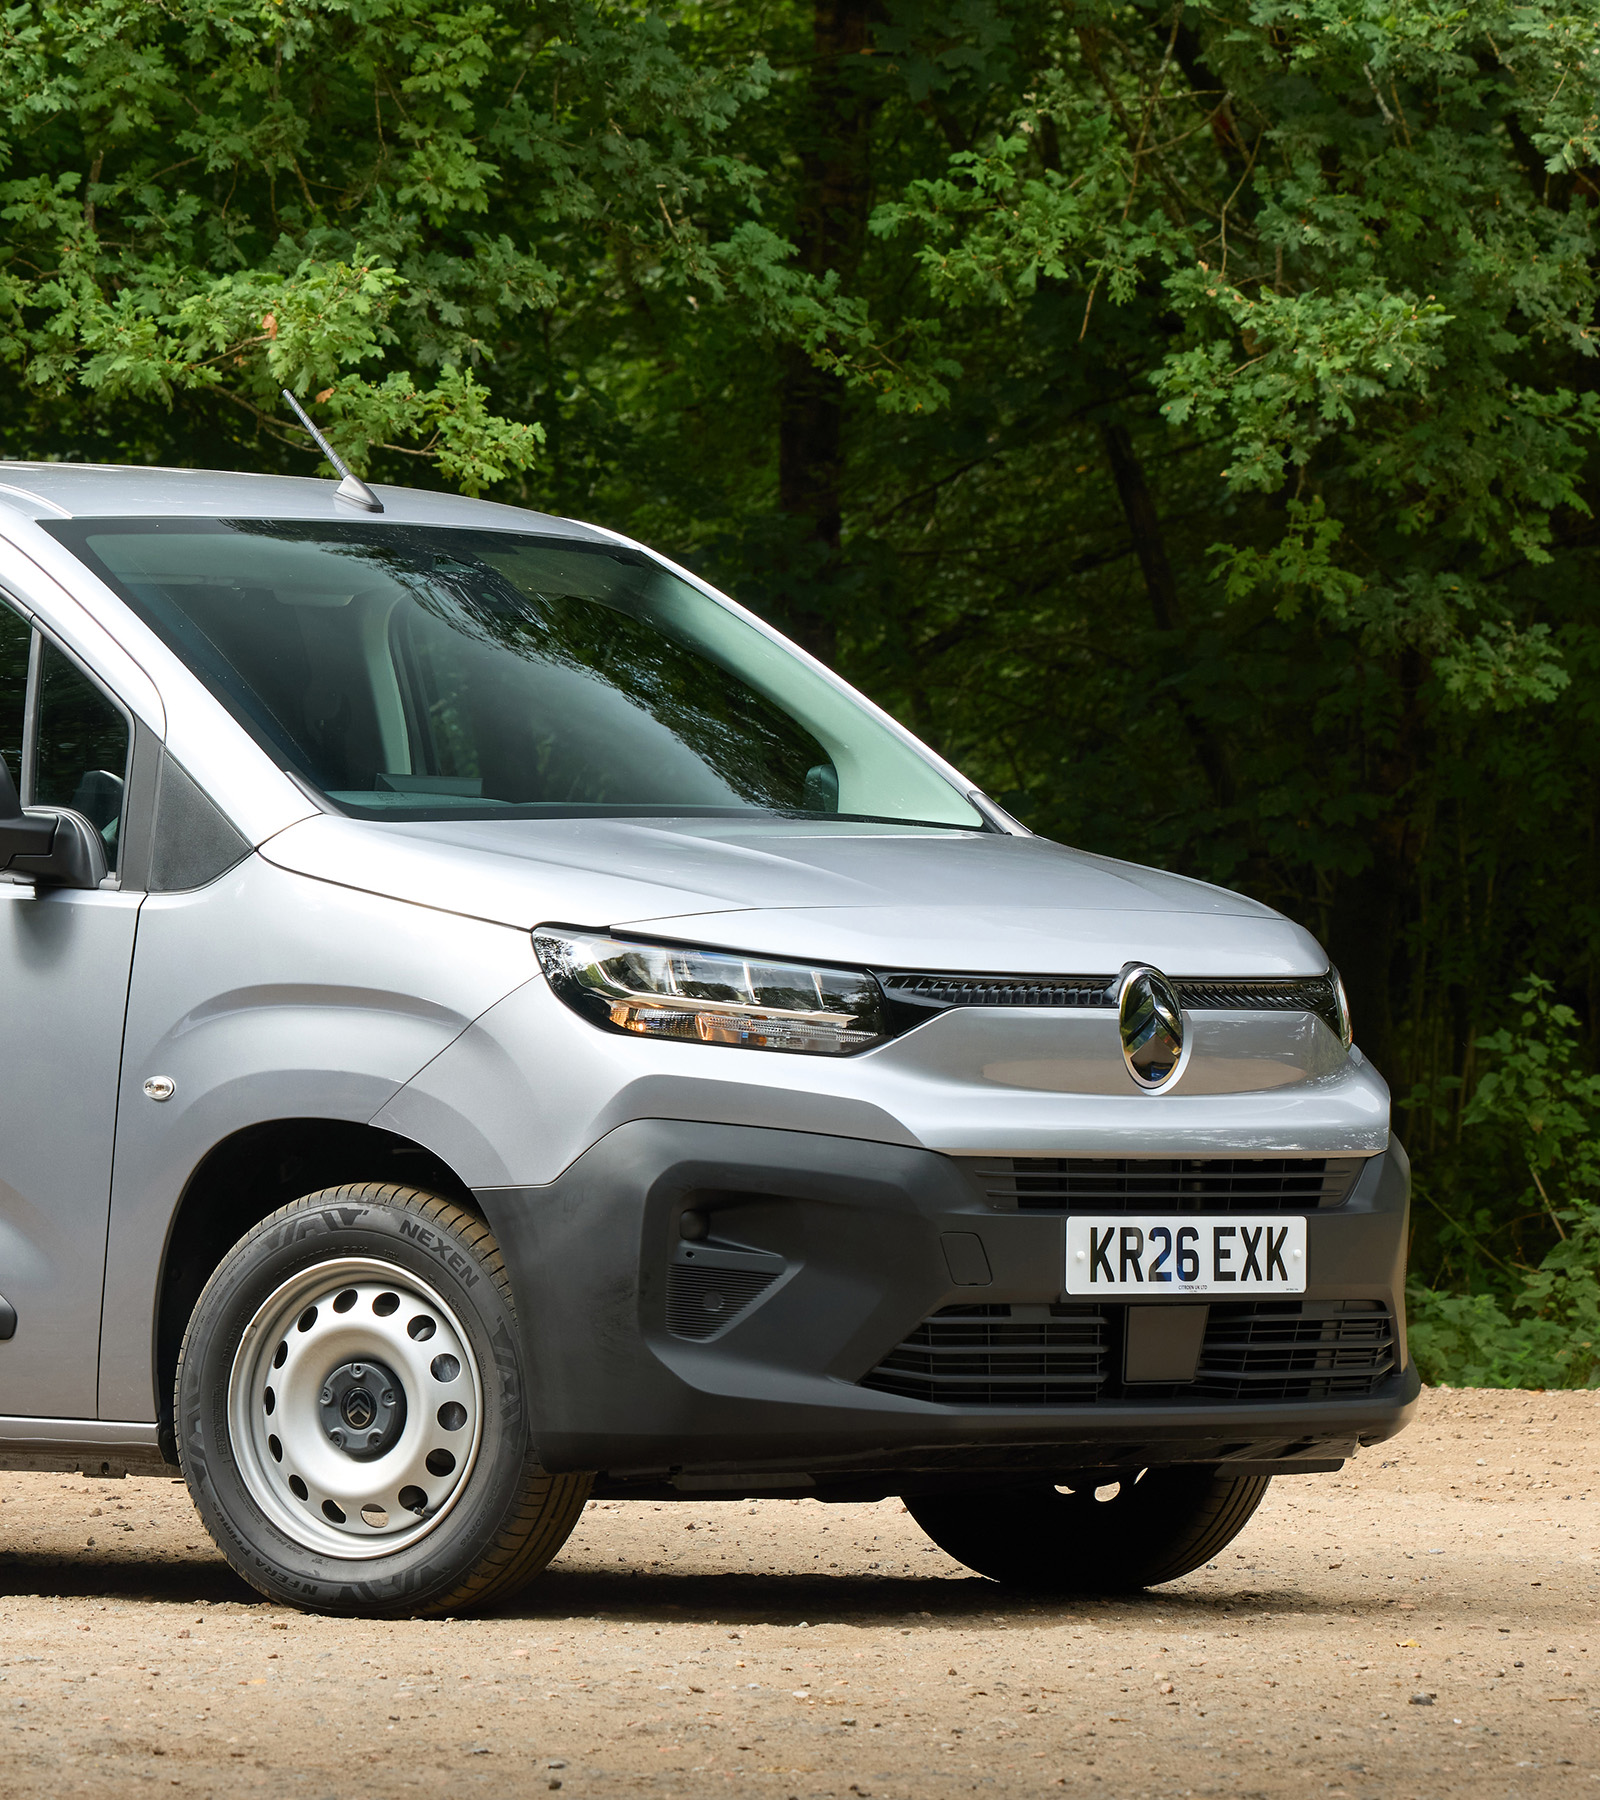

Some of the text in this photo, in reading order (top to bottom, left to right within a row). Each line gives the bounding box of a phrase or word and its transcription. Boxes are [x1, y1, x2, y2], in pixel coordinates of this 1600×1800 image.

[398, 1219, 481, 1289] NEXEN
[1089, 1226, 1289, 1283] KR26 EXK
